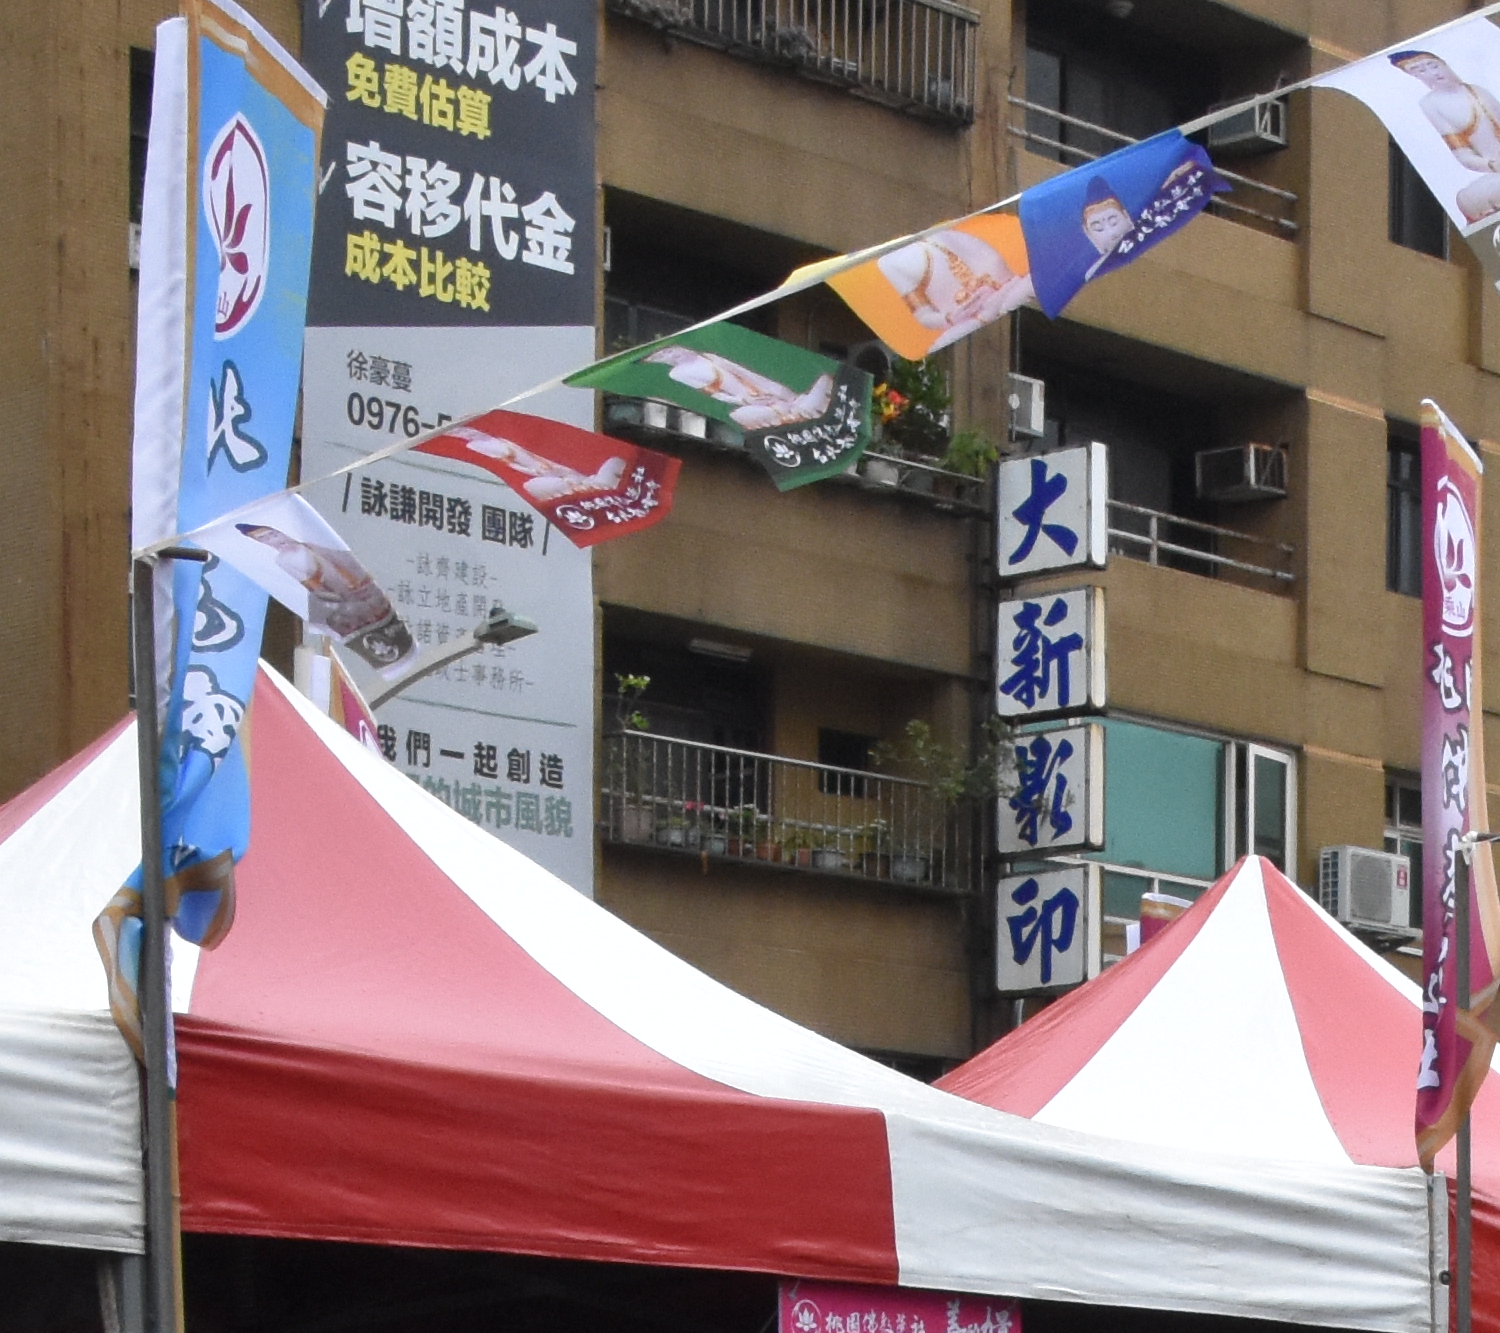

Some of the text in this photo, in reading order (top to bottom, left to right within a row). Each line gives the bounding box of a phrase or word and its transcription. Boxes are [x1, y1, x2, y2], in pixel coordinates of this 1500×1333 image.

[345, 53, 492, 141] 免費估算
[346, 141, 576, 275] 容移代金
[345, 232, 491, 313] 成本比較
[481, 503, 534, 549] 團隊
[999, 458, 1086, 985] 大新影印
